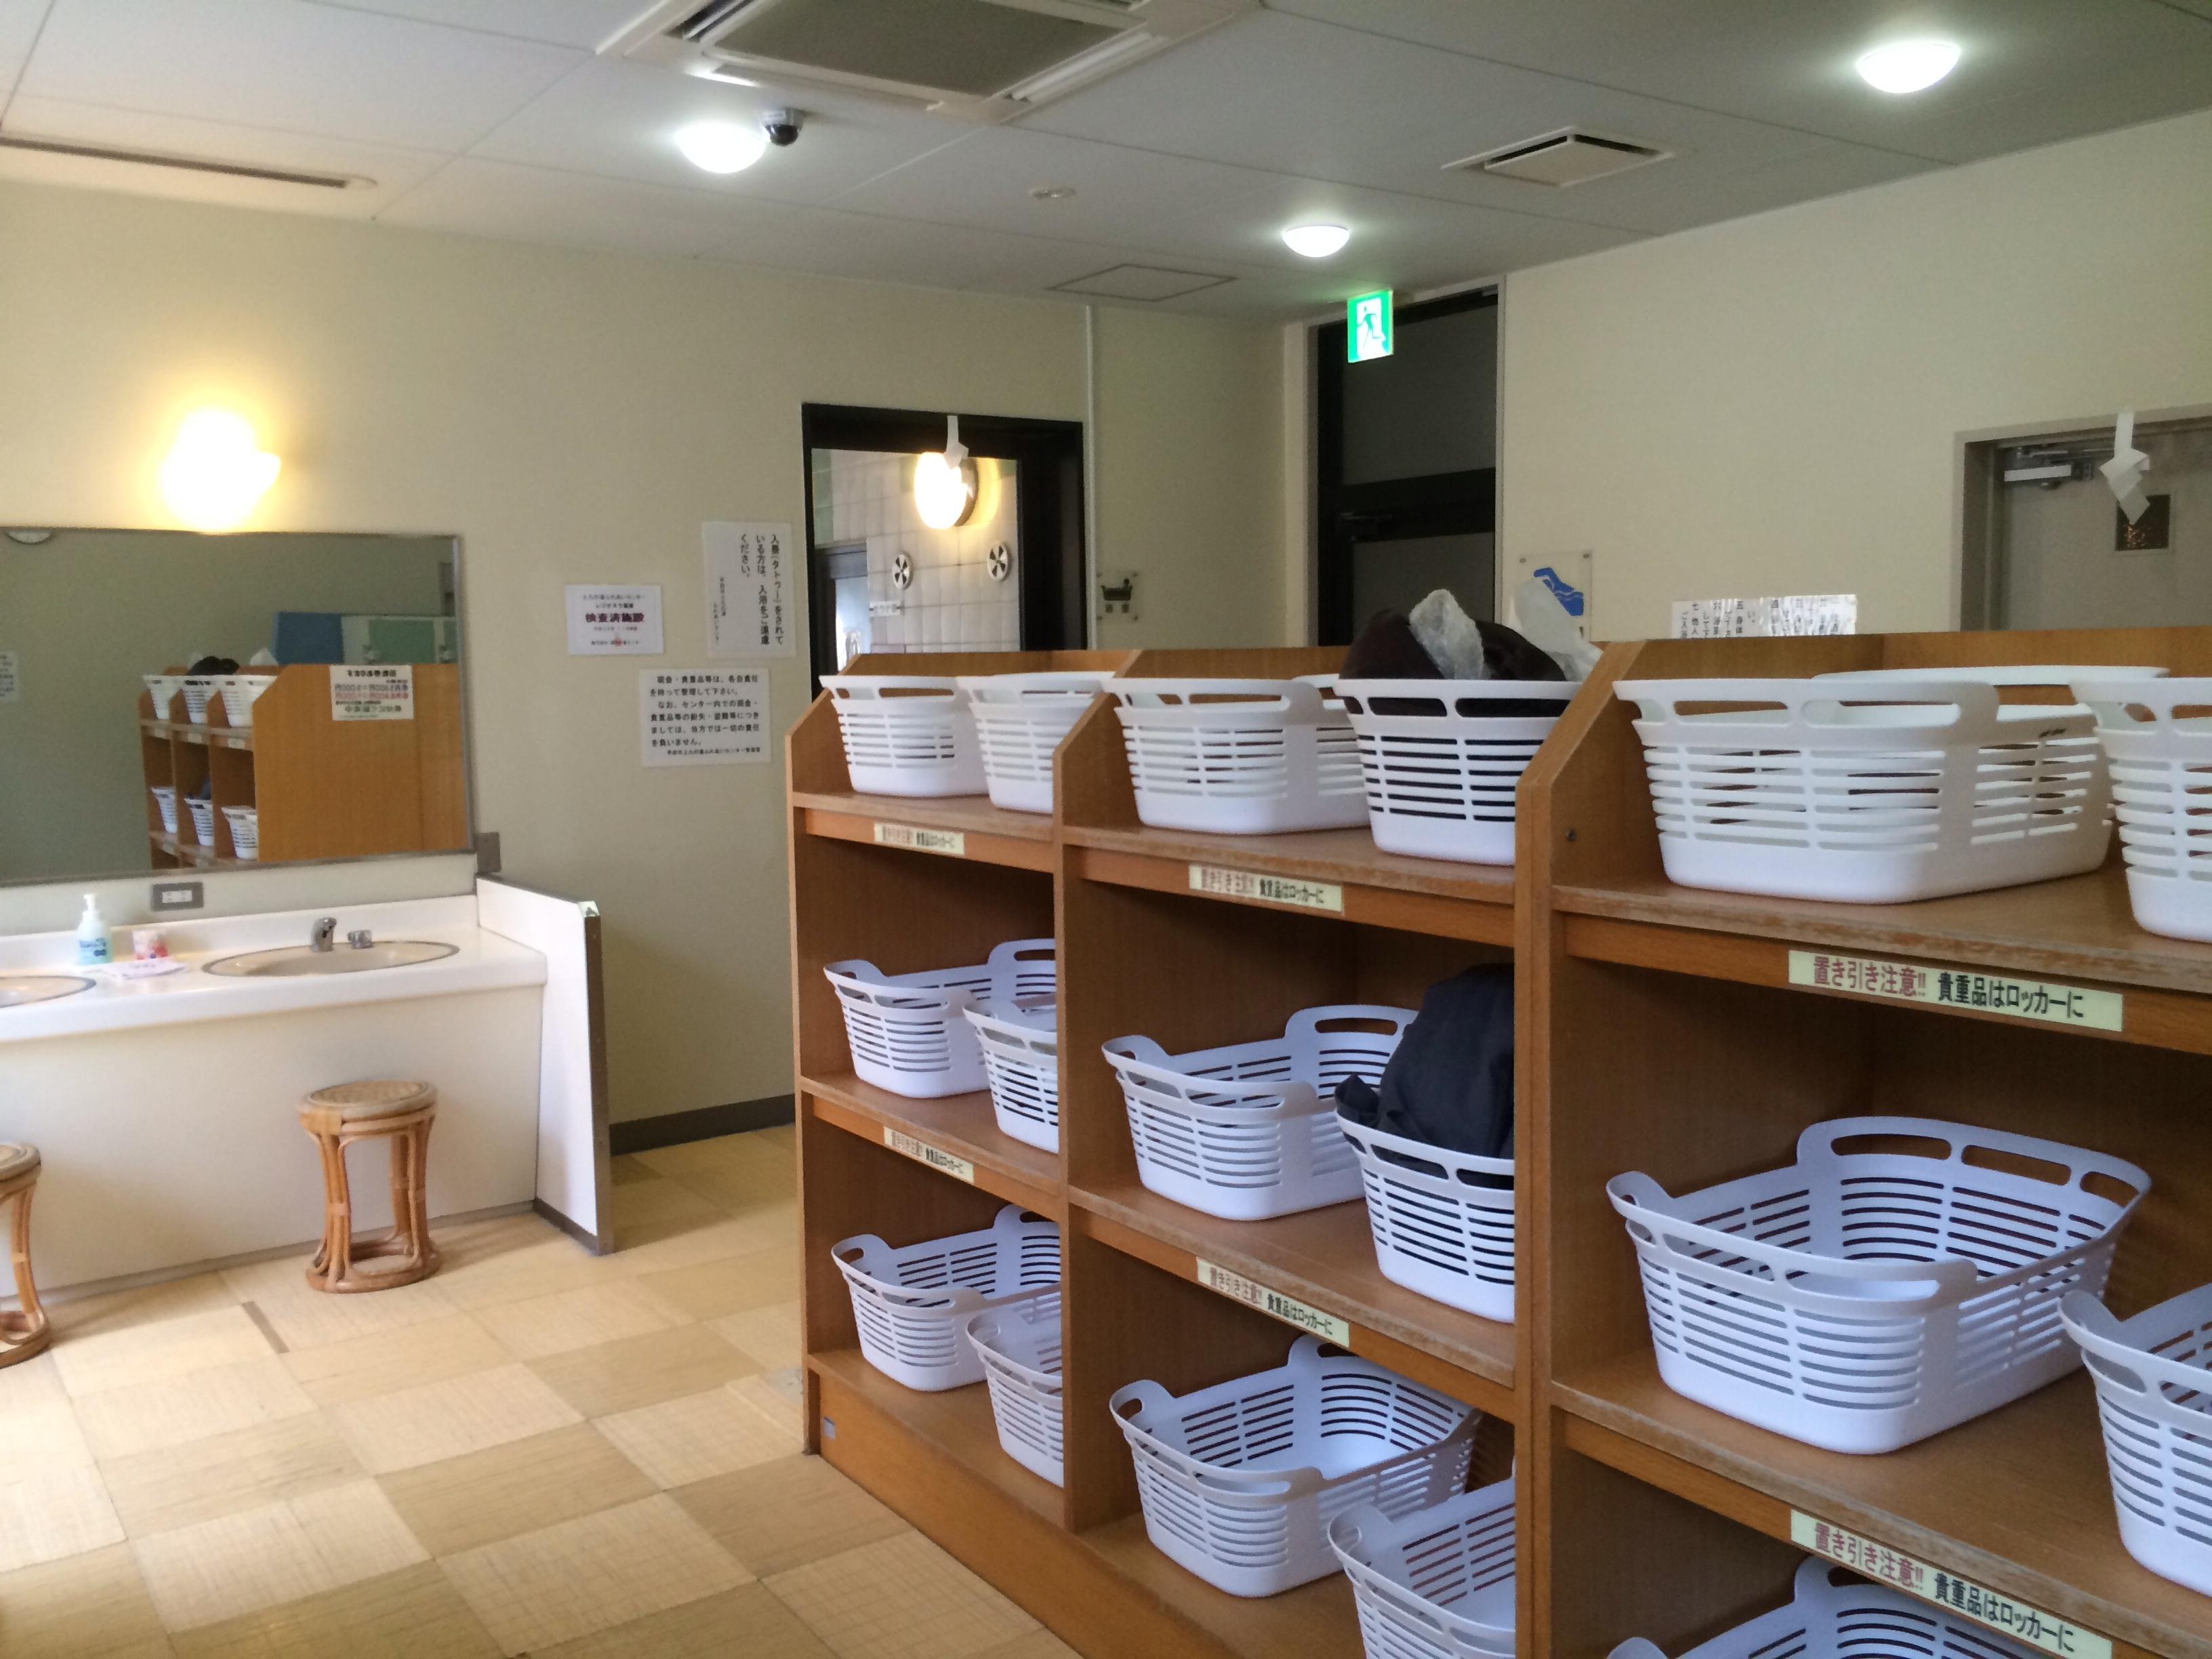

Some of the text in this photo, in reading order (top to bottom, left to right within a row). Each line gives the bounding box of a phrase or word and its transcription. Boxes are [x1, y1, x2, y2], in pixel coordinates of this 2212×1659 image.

[740, 533, 751, 578] ください。
[1692, 602, 1699, 611] 七
[1937, 971, 2085, 1019] 貴重品はロッカーに
[1267, 1292, 1334, 1336] 貴重品はロッカーに
[1934, 1571, 2075, 1653] 貴重品はロッカーに
